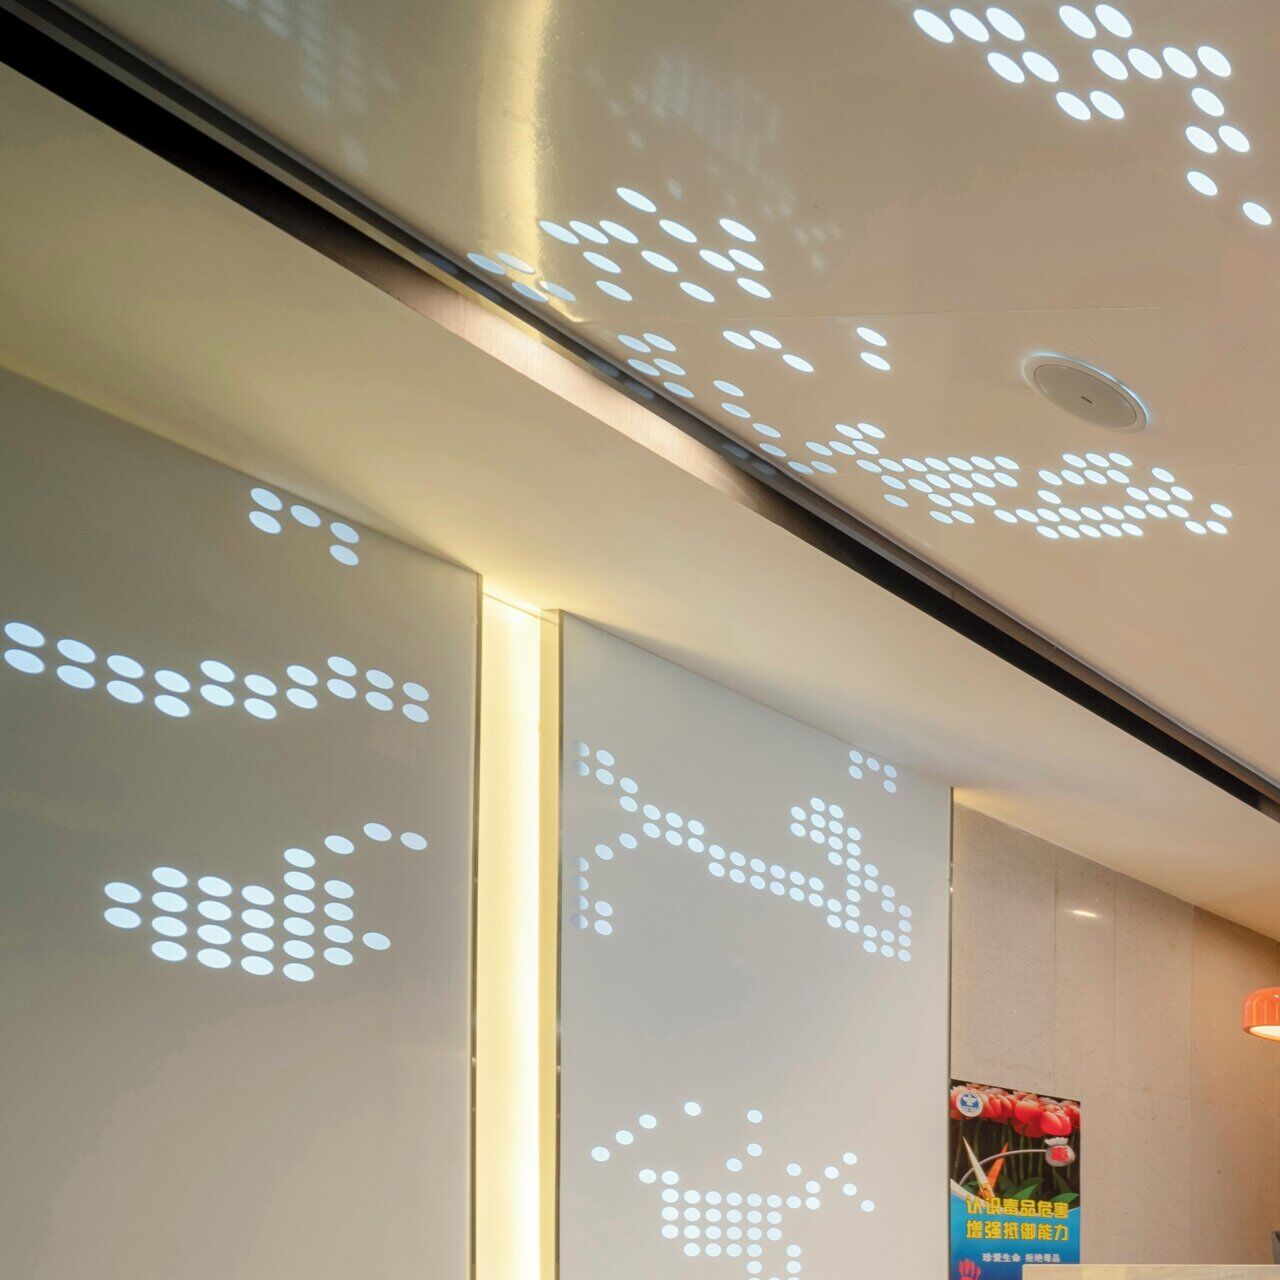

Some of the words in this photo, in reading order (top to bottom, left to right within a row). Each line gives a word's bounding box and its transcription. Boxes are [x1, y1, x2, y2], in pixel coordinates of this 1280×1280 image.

[965, 1196, 1068, 1219] 认识毒品危害
[966, 1220, 1068, 1241] 增强抵御能力
[982, 1252, 1021, 1263] 珍爱生命
[1025, 1253, 1060, 1263] 拒绝毒品
